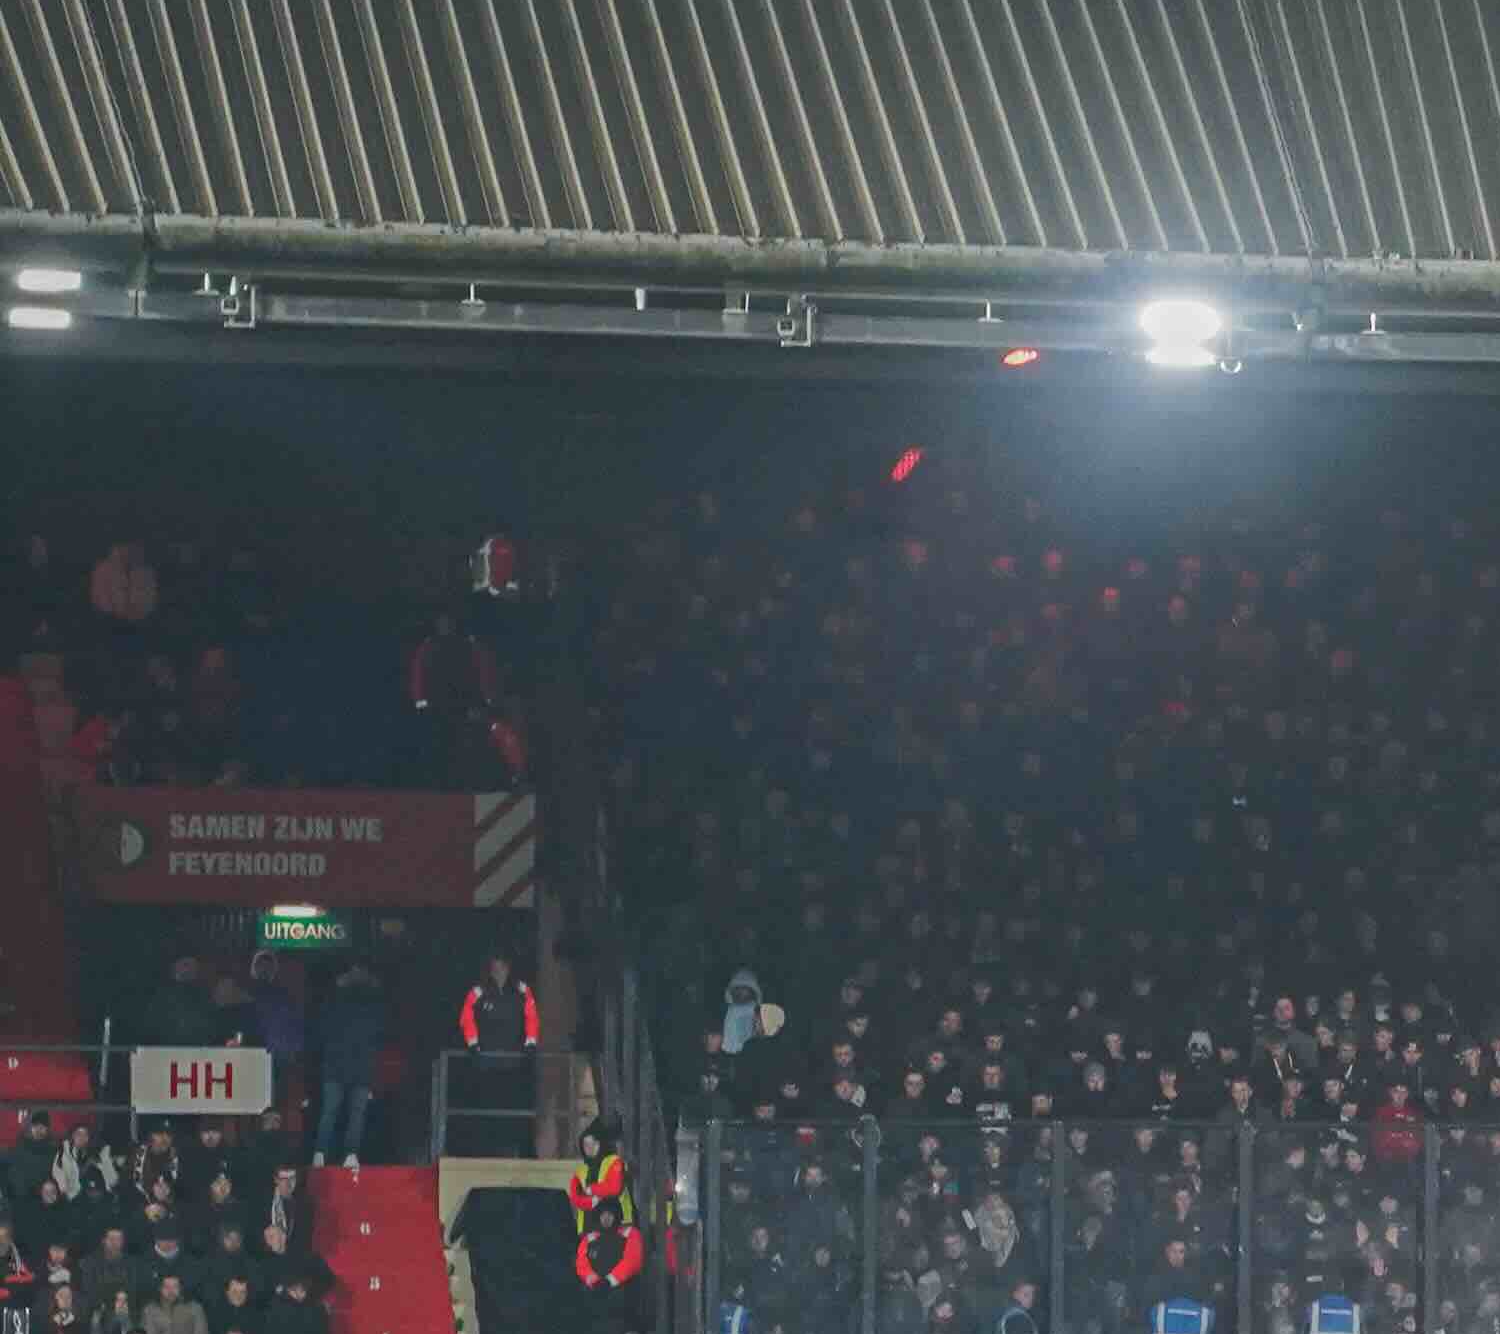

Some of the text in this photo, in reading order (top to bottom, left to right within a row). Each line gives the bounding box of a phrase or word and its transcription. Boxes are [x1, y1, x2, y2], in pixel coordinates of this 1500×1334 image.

[168, 814, 383, 842] SAMEN ZIJN WE
[168, 853, 327, 877] FEYENOORD
[264, 921, 346, 940] UITGANG
[169, 1062, 234, 1100] HH
